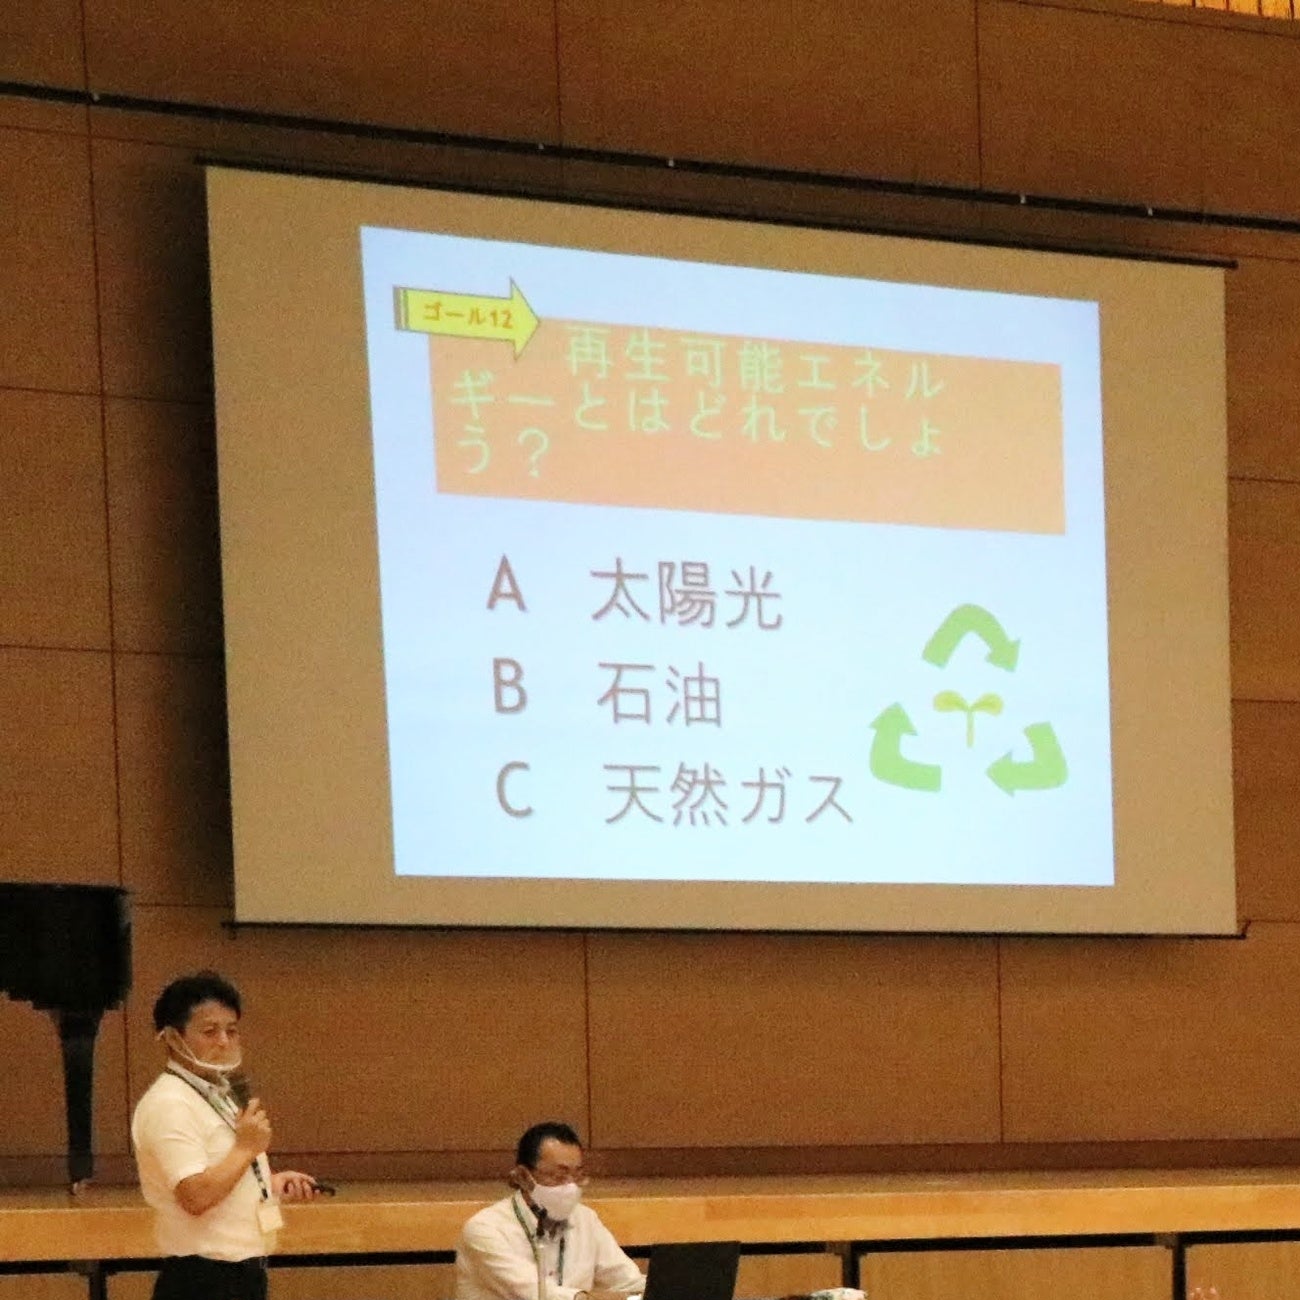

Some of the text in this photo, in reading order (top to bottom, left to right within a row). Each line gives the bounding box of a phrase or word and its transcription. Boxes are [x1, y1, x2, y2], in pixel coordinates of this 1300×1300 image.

[423, 301, 513, 329] ゴール12
[565, 326, 945, 400] 再生可能エネル
[452, 369, 943, 459] ギーとはどれでしょ
[486, 554, 783, 631] A 太陽光
[493, 657, 722, 728] B 石油
[496, 761, 854, 827] C 天然ガス
